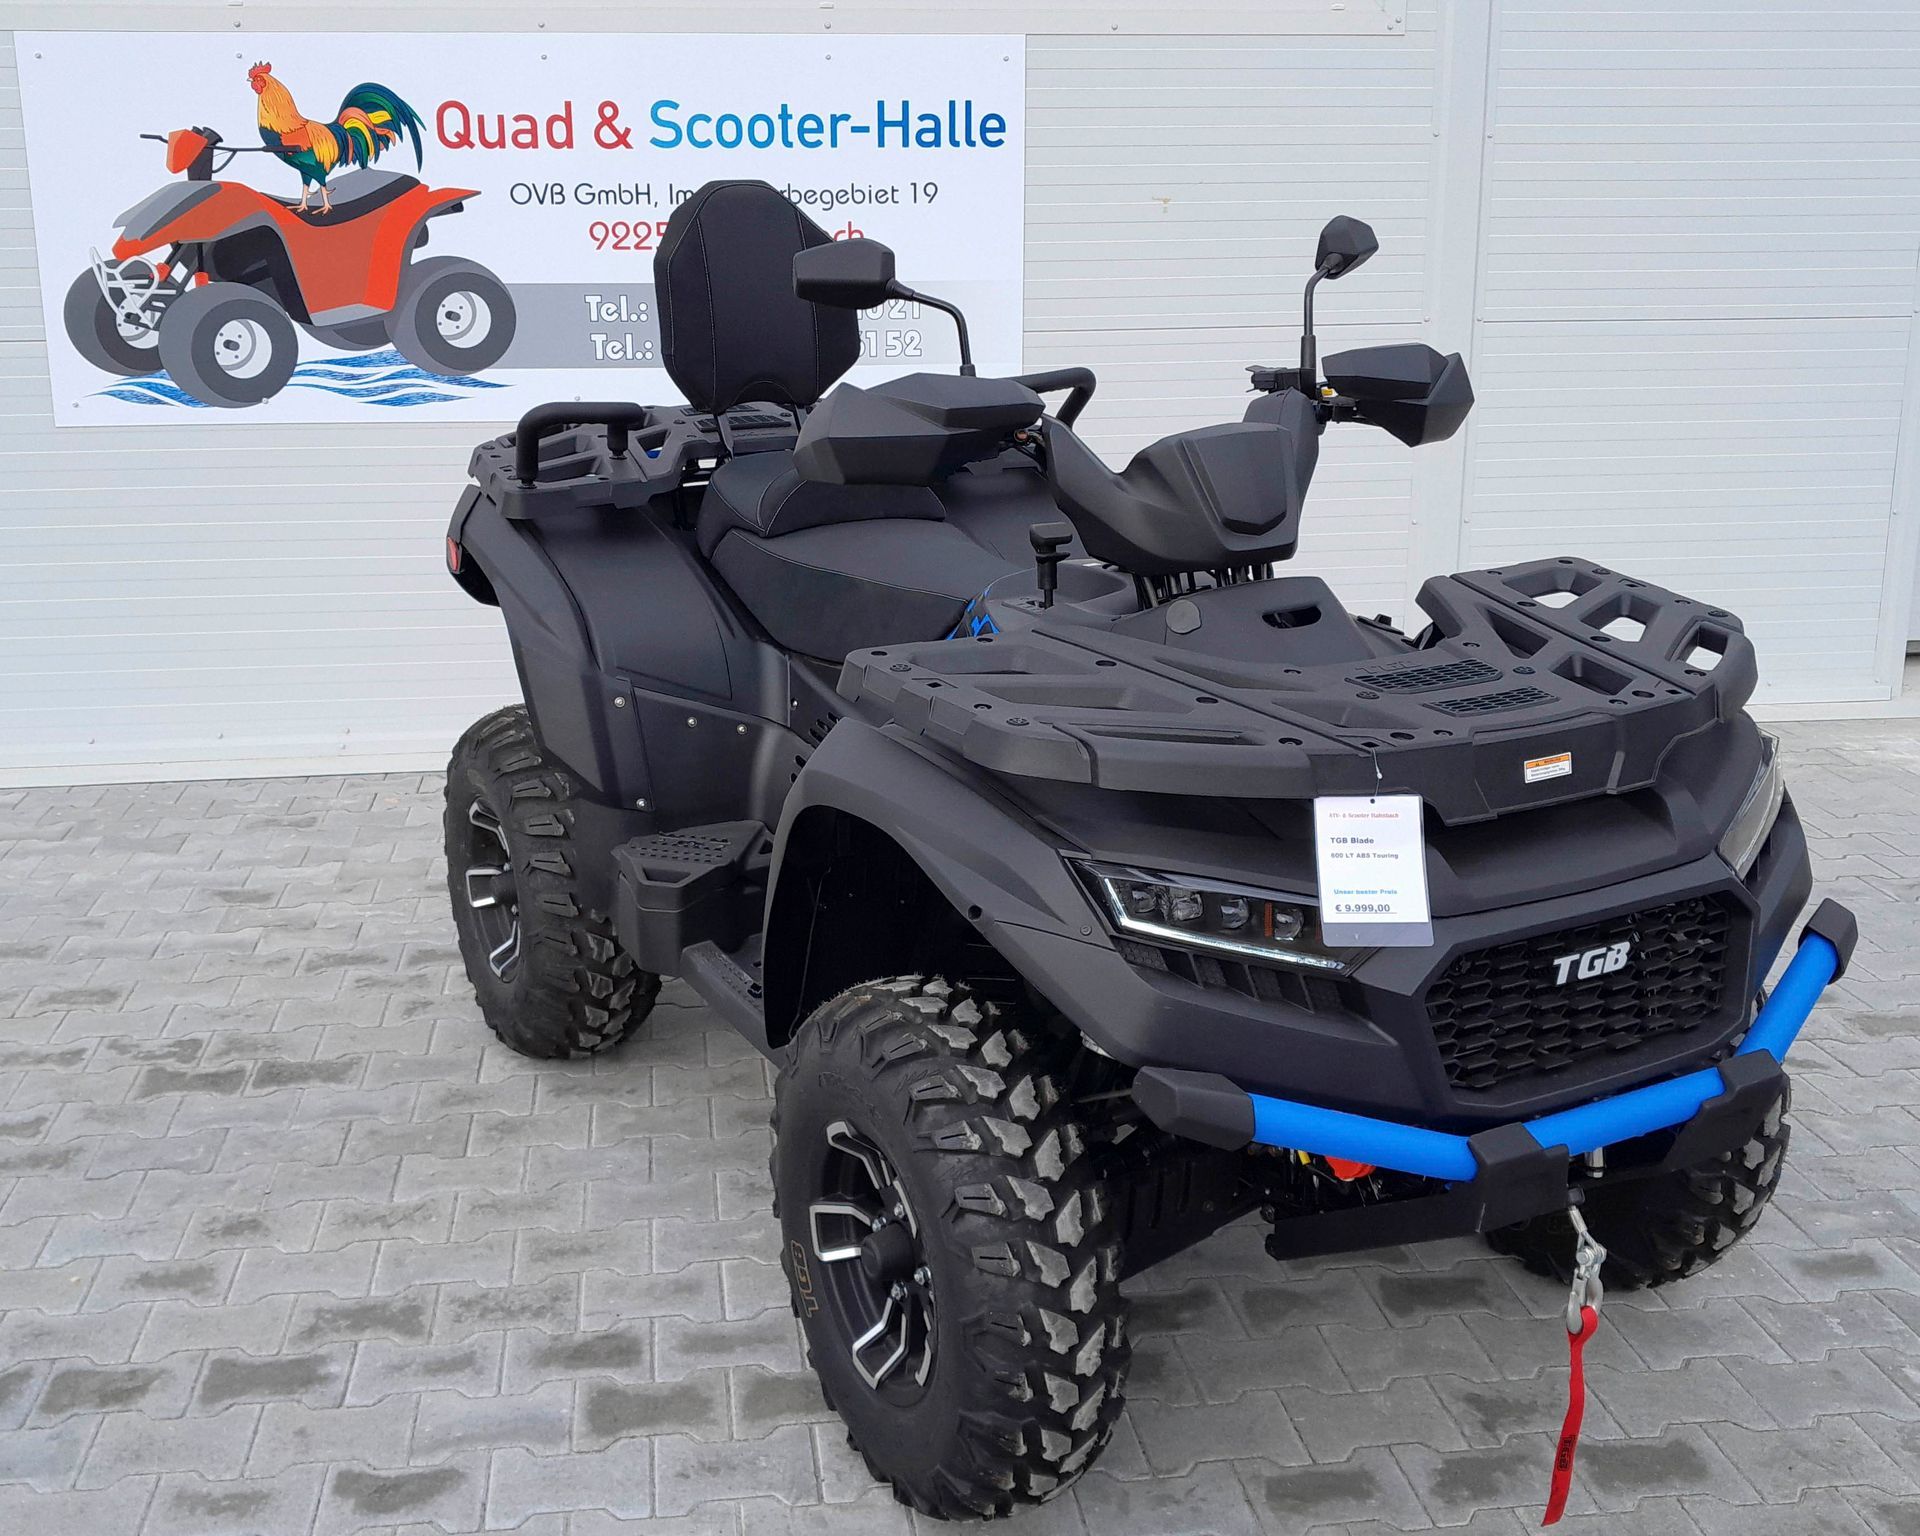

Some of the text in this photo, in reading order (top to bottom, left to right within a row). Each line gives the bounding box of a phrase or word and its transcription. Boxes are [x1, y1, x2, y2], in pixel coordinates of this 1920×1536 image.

[436, 99, 1006, 150] Quad & Scooter-Halle
[574, 182, 658, 208] GmbH,
[910, 182, 938, 204] 19
[584, 294, 648, 322] Tel.:
[590, 333, 653, 360] Tel.:
[1330, 836, 1374, 844] TGB Blade
[1345, 904, 1390, 913] 9.999,00
[1553, 941, 1630, 985] TGB
